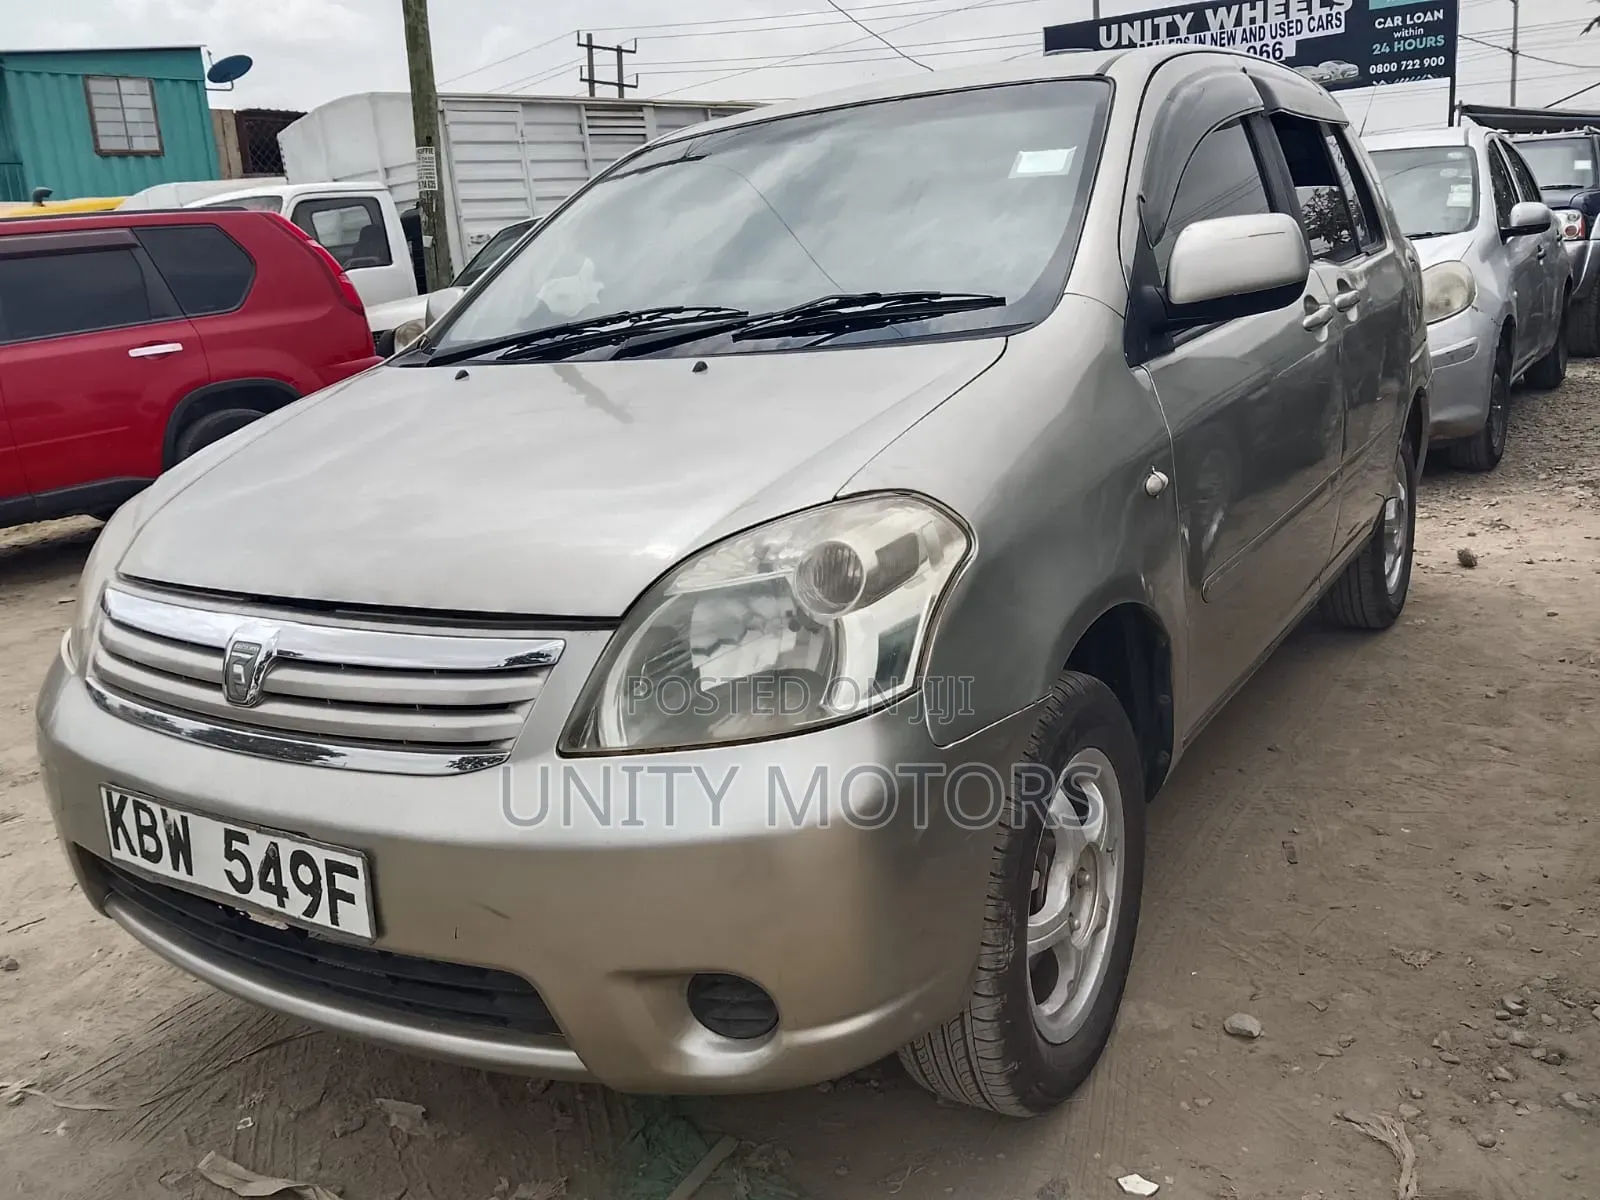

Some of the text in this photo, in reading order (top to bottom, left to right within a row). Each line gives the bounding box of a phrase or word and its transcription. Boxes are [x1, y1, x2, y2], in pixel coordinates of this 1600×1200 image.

[1099, 0, 1353, 48] UNITY WHEELS
[1210, 29, 1237, 47] NEW
[1240, 25, 1266, 44] AND
[1269, 18, 1303, 40] USED
[1307, 11, 1342, 33] CARS
[1374, 9, 1444, 29] CAR LOAN
[1393, 26, 1424, 38] within
[1372, 35, 1445, 55] 24 HOURS
[1369, 56, 1445, 74] 0800 722 900
[103, 790, 359, 928] KBW 549F
